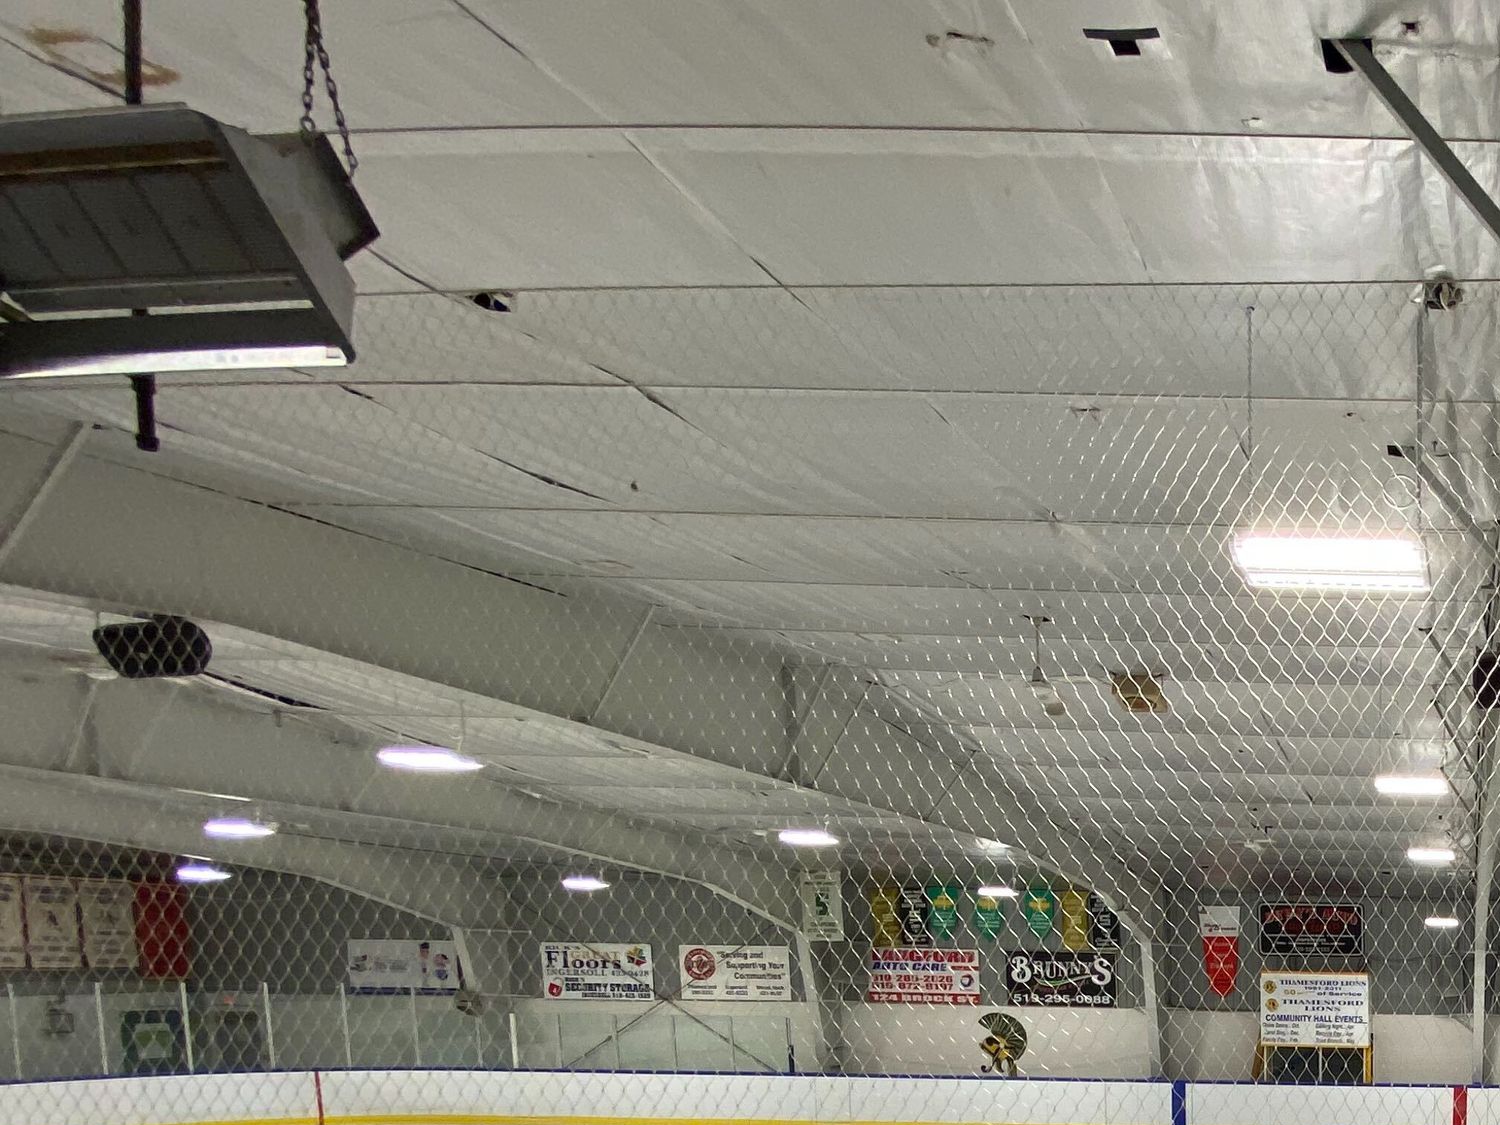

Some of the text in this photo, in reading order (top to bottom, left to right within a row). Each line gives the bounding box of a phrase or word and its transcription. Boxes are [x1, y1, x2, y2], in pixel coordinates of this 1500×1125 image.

[545, 950, 622, 969] Floors
[912, 962, 947, 972] CARE
[1265, 1014, 1364, 1024] COMMUNITY HALL EVENTS
